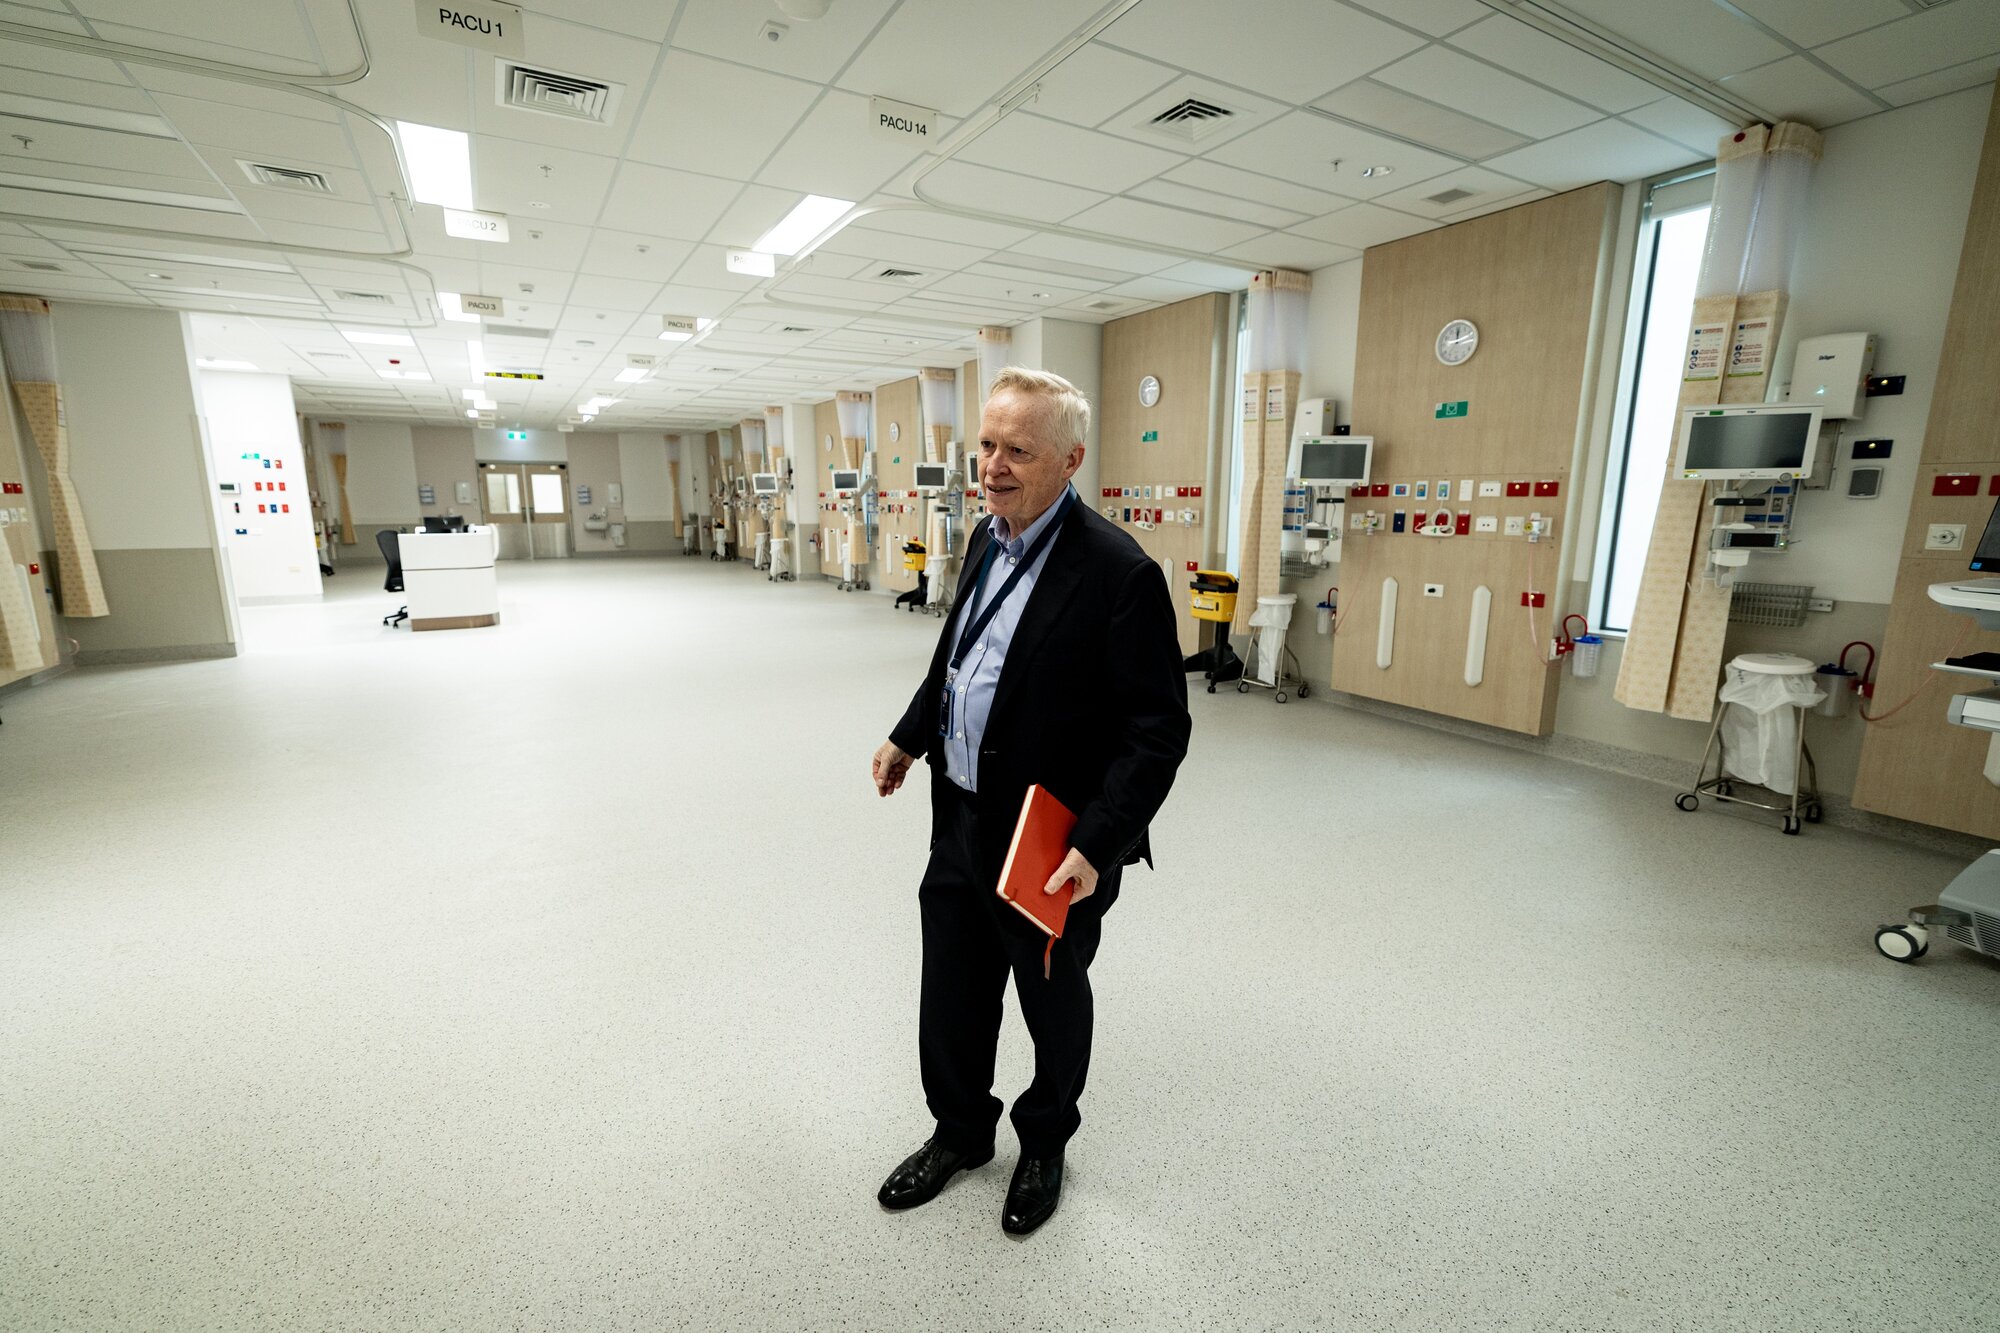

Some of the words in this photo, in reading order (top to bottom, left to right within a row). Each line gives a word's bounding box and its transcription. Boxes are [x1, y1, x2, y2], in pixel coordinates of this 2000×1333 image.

[439, 8, 491, 34] PACU
[495, 22, 502, 37] 1
[880, 113, 913, 133] PACU
[915, 122, 927, 136] 14
[457, 217, 488, 231] ACU
[490, 222, 497, 231] 2
[467, 301, 490, 310] PACU
[490, 303, 496, 311] 3
[667, 320, 686, 329] PACU
